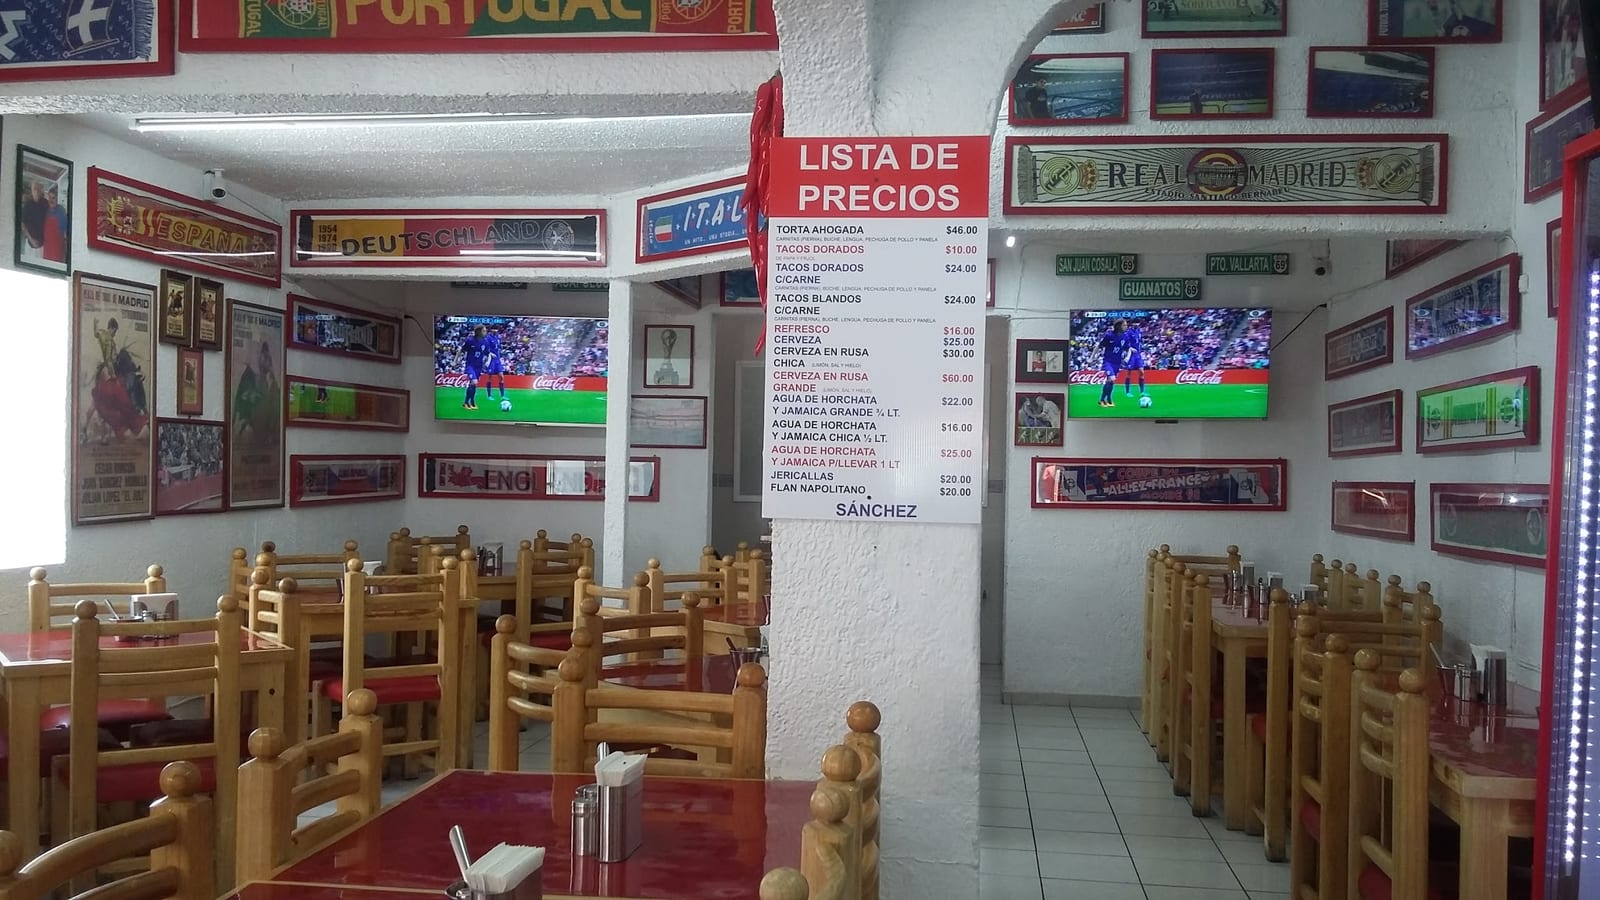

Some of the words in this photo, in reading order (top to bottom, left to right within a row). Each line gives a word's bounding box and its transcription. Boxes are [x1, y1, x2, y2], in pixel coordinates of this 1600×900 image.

[800, 144, 899, 170] LISTA
[911, 143, 959, 170] DE
[1108, 162, 1186, 188] REAL
[1250, 161, 1346, 188] MADRID
[799, 184, 960, 212] PRECIOS
[1144, 187, 1185, 199] ESTADIO
[1190, 193, 1238, 201] SANTIAGO
[1241, 187, 1290, 199] BERNABEU
[683, 195, 743, 232] ITAL
[319, 224, 337, 233] 1954
[812, 226, 864, 234] AHOGADA
[947, 226, 977, 234] $46.00
[319, 234, 337, 243] 1974
[341, 219, 541, 256] DEUTSCHLAND
[776, 245, 810, 253] TACOS
[814, 245, 864, 253] DORADOS
[946, 246, 977, 254] $10.00
[813, 264, 863, 272] DORADOS
[945, 264, 976, 272] $24.00
[1059, 257, 1072, 272] SAN
[1073, 257, 1090, 272] JUAN
[1092, 257, 1117, 272] COSALA
[1124, 261, 1132, 270] 69
[1210, 257, 1228, 272] PTO.
[1229, 257, 1269, 272] VALLARTA
[1276, 260, 1285, 270] 69
[1123, 282, 1181, 297] GUANATOS
[1186, 285, 1196, 294] 69
[118, 295, 149, 309] MADRID
[775, 294, 808, 302] TACOS
[813, 295, 861, 303] BLANDOS
[945, 296, 975, 304] $24.00
[775, 306, 820, 314] C/CARNE
[775, 325, 829, 333] REFRESCO
[944, 327, 974, 335] $16.00
[775, 336, 821, 344] CERVEZA
[944, 338, 974, 346] $25.00
[774, 347, 821, 355] CERVEZA
[841, 348, 869, 356] RUSA
[943, 349, 974, 358] $30.00
[774, 359, 805, 367] CHICA
[774, 371, 820, 380] CERVEZA
[824, 372, 836, 380] EN
[841, 373, 868, 381] RUSA
[943, 374, 973, 382] $60.00
[773, 383, 816, 392] GRANDE
[773, 394, 802, 402] AGUA
[805, 395, 818, 403] DE
[822, 395, 877, 404] HORCHATA
[942, 397, 973, 406] $22.00
[782, 407, 827, 415] JAMAICA
[830, 408, 873, 416] GRANDE
[888, 409, 900, 417] LT.
[772, 420, 801, 428] AGUA
[804, 421, 817, 429] DE
[821, 421, 876, 430] HORCHATA
[942, 423, 972, 432] $16.00
[781, 432, 826, 441] JAMAICA
[829, 434, 861, 442] CHICA
[772, 446, 800, 454] AGUA
[804, 446, 817, 454] DE
[821, 447, 876, 455] HORCHATA
[941, 449, 971, 458] $25.00
[781, 458, 825, 466] JAMAICA
[829, 459, 877, 468] P/LLEVAR
[880, 460, 885, 468] 1
[771, 471, 833, 480] JERICALLAS
[941, 475, 971, 483] $20.00
[771, 483, 797, 492] FLAN
[801, 484, 865, 494] NAPOLITANO
[940, 488, 971, 496] $20.00
[1108, 480, 1148, 496] ALLEZ
[1151, 473, 1202, 490] FRANCE
[836, 500, 917, 518] SÁNCHEZ
